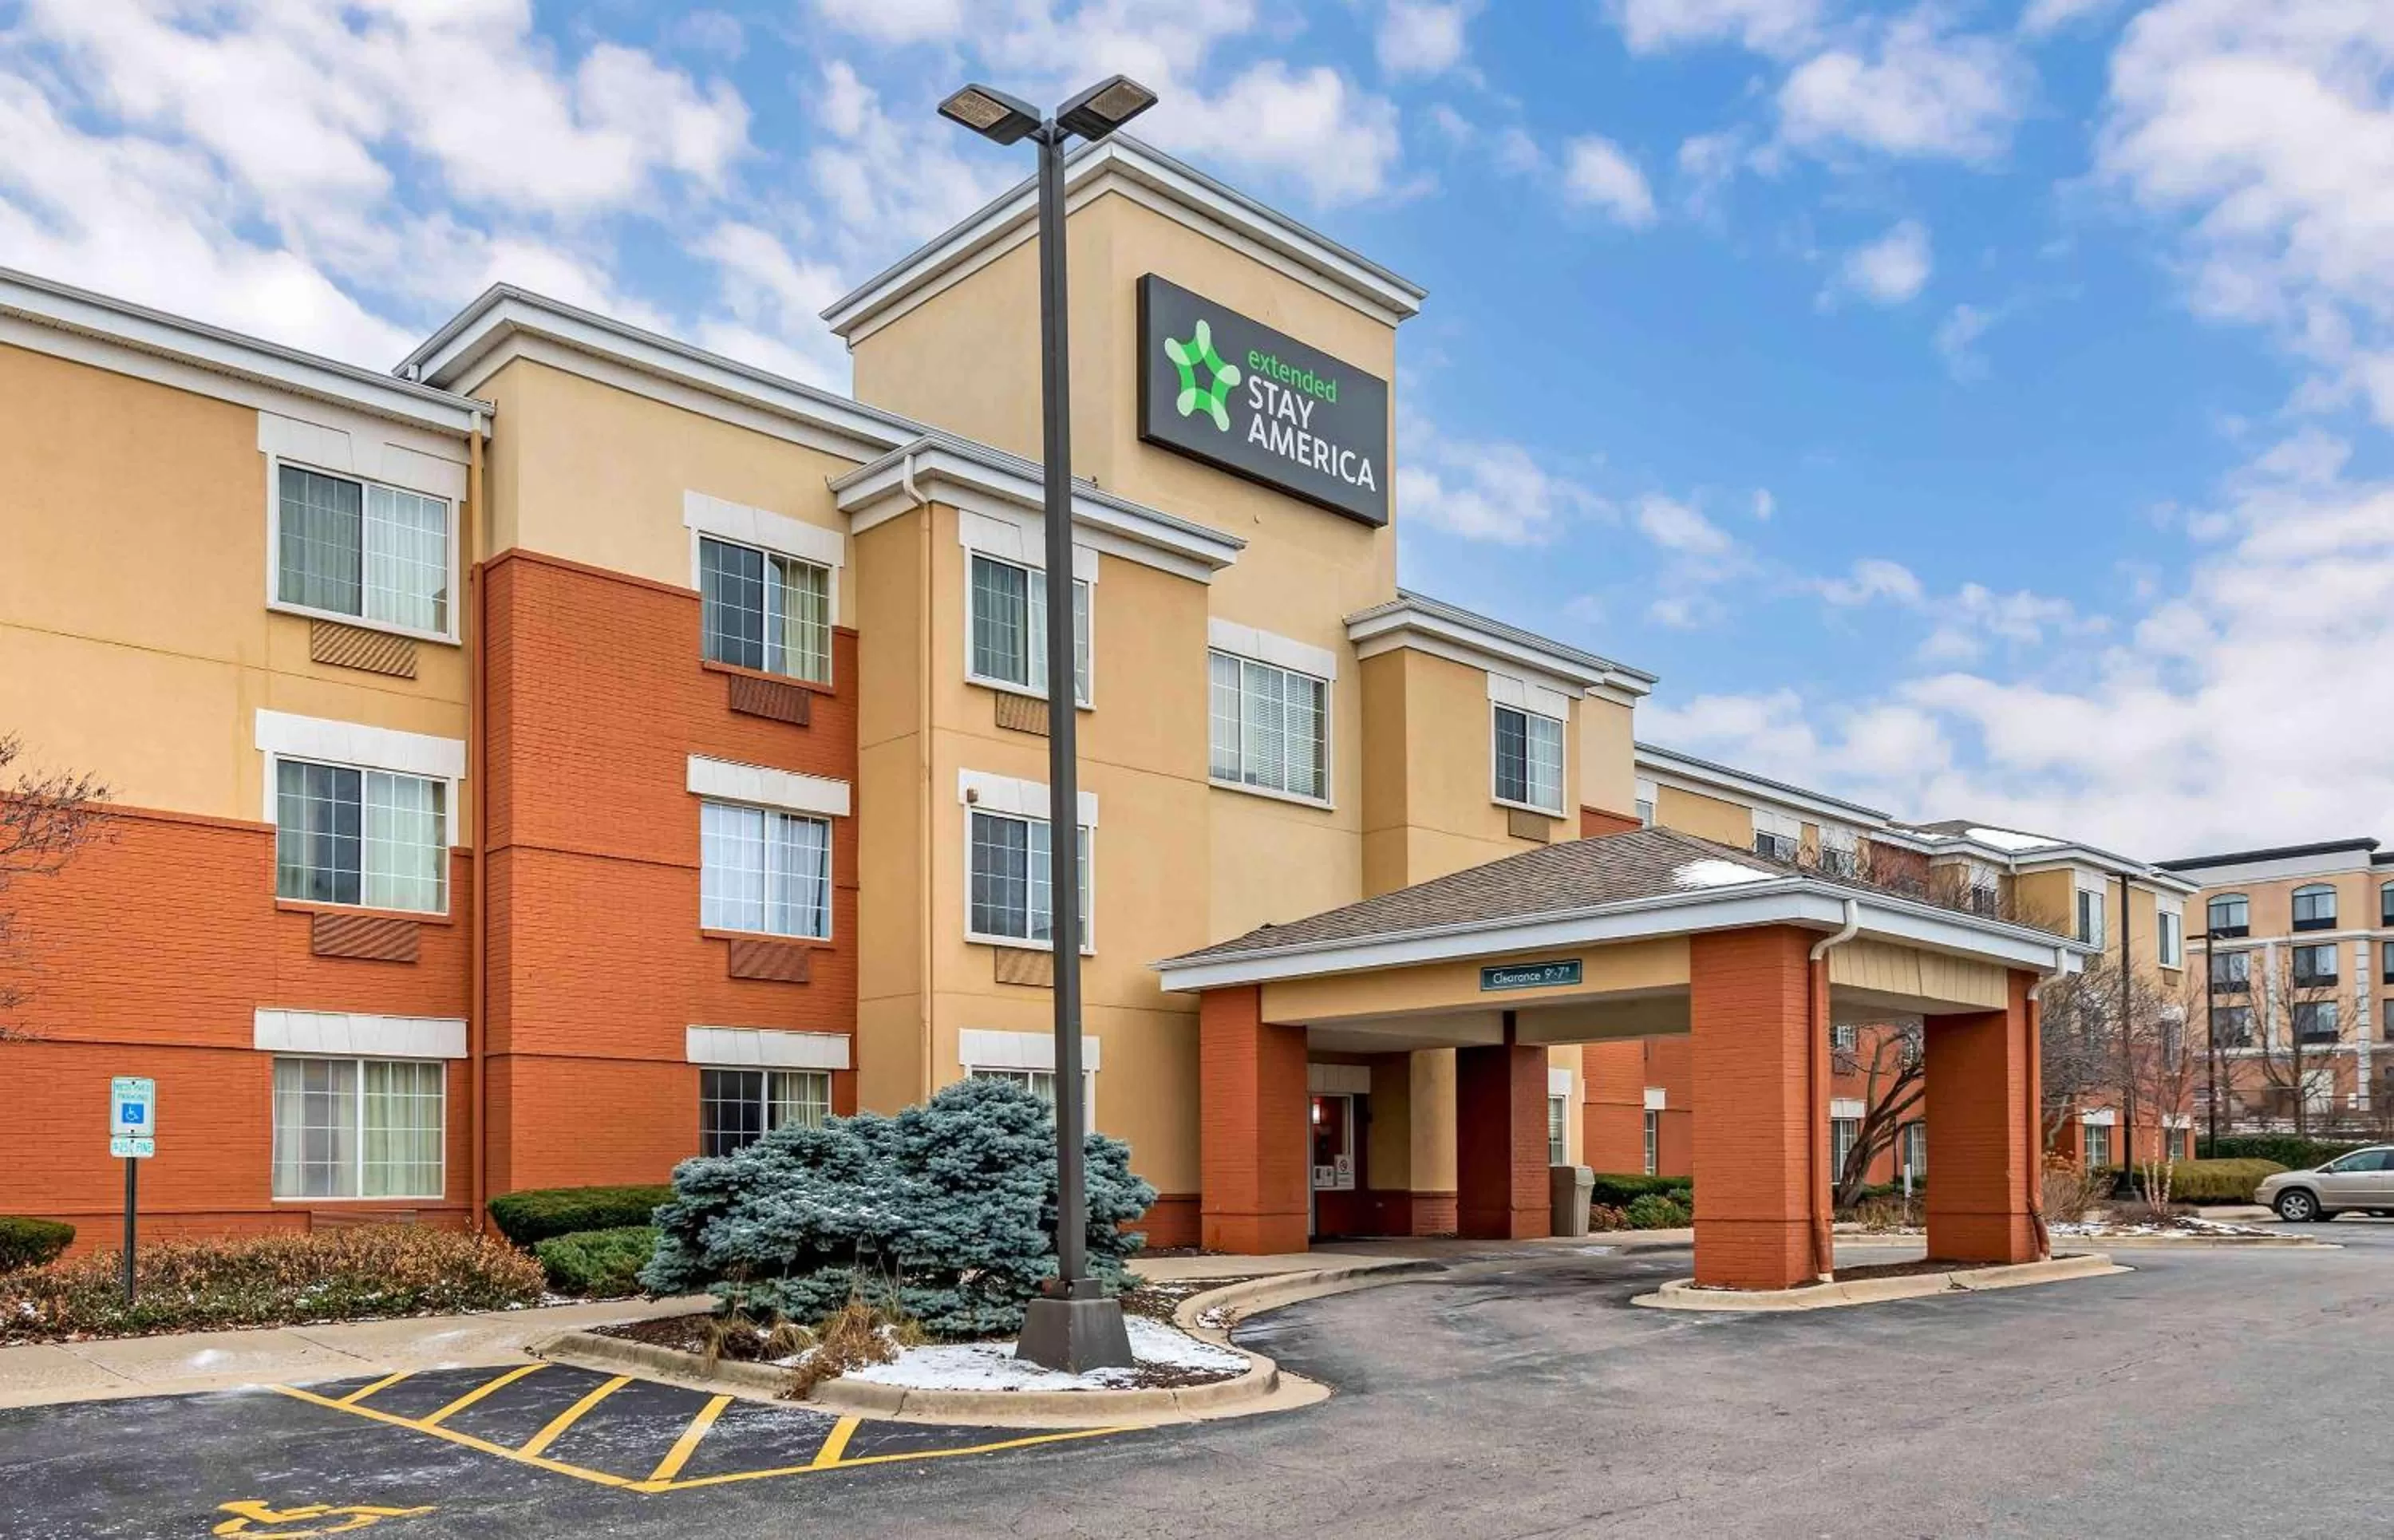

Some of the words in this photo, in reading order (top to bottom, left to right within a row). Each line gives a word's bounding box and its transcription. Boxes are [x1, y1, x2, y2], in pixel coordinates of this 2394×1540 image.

[1248, 349, 1337, 403] extended
[1248, 375, 1314, 429] STAY
[1247, 413, 1376, 492] AMERICA
[1493, 971, 1541, 984] Clearance
